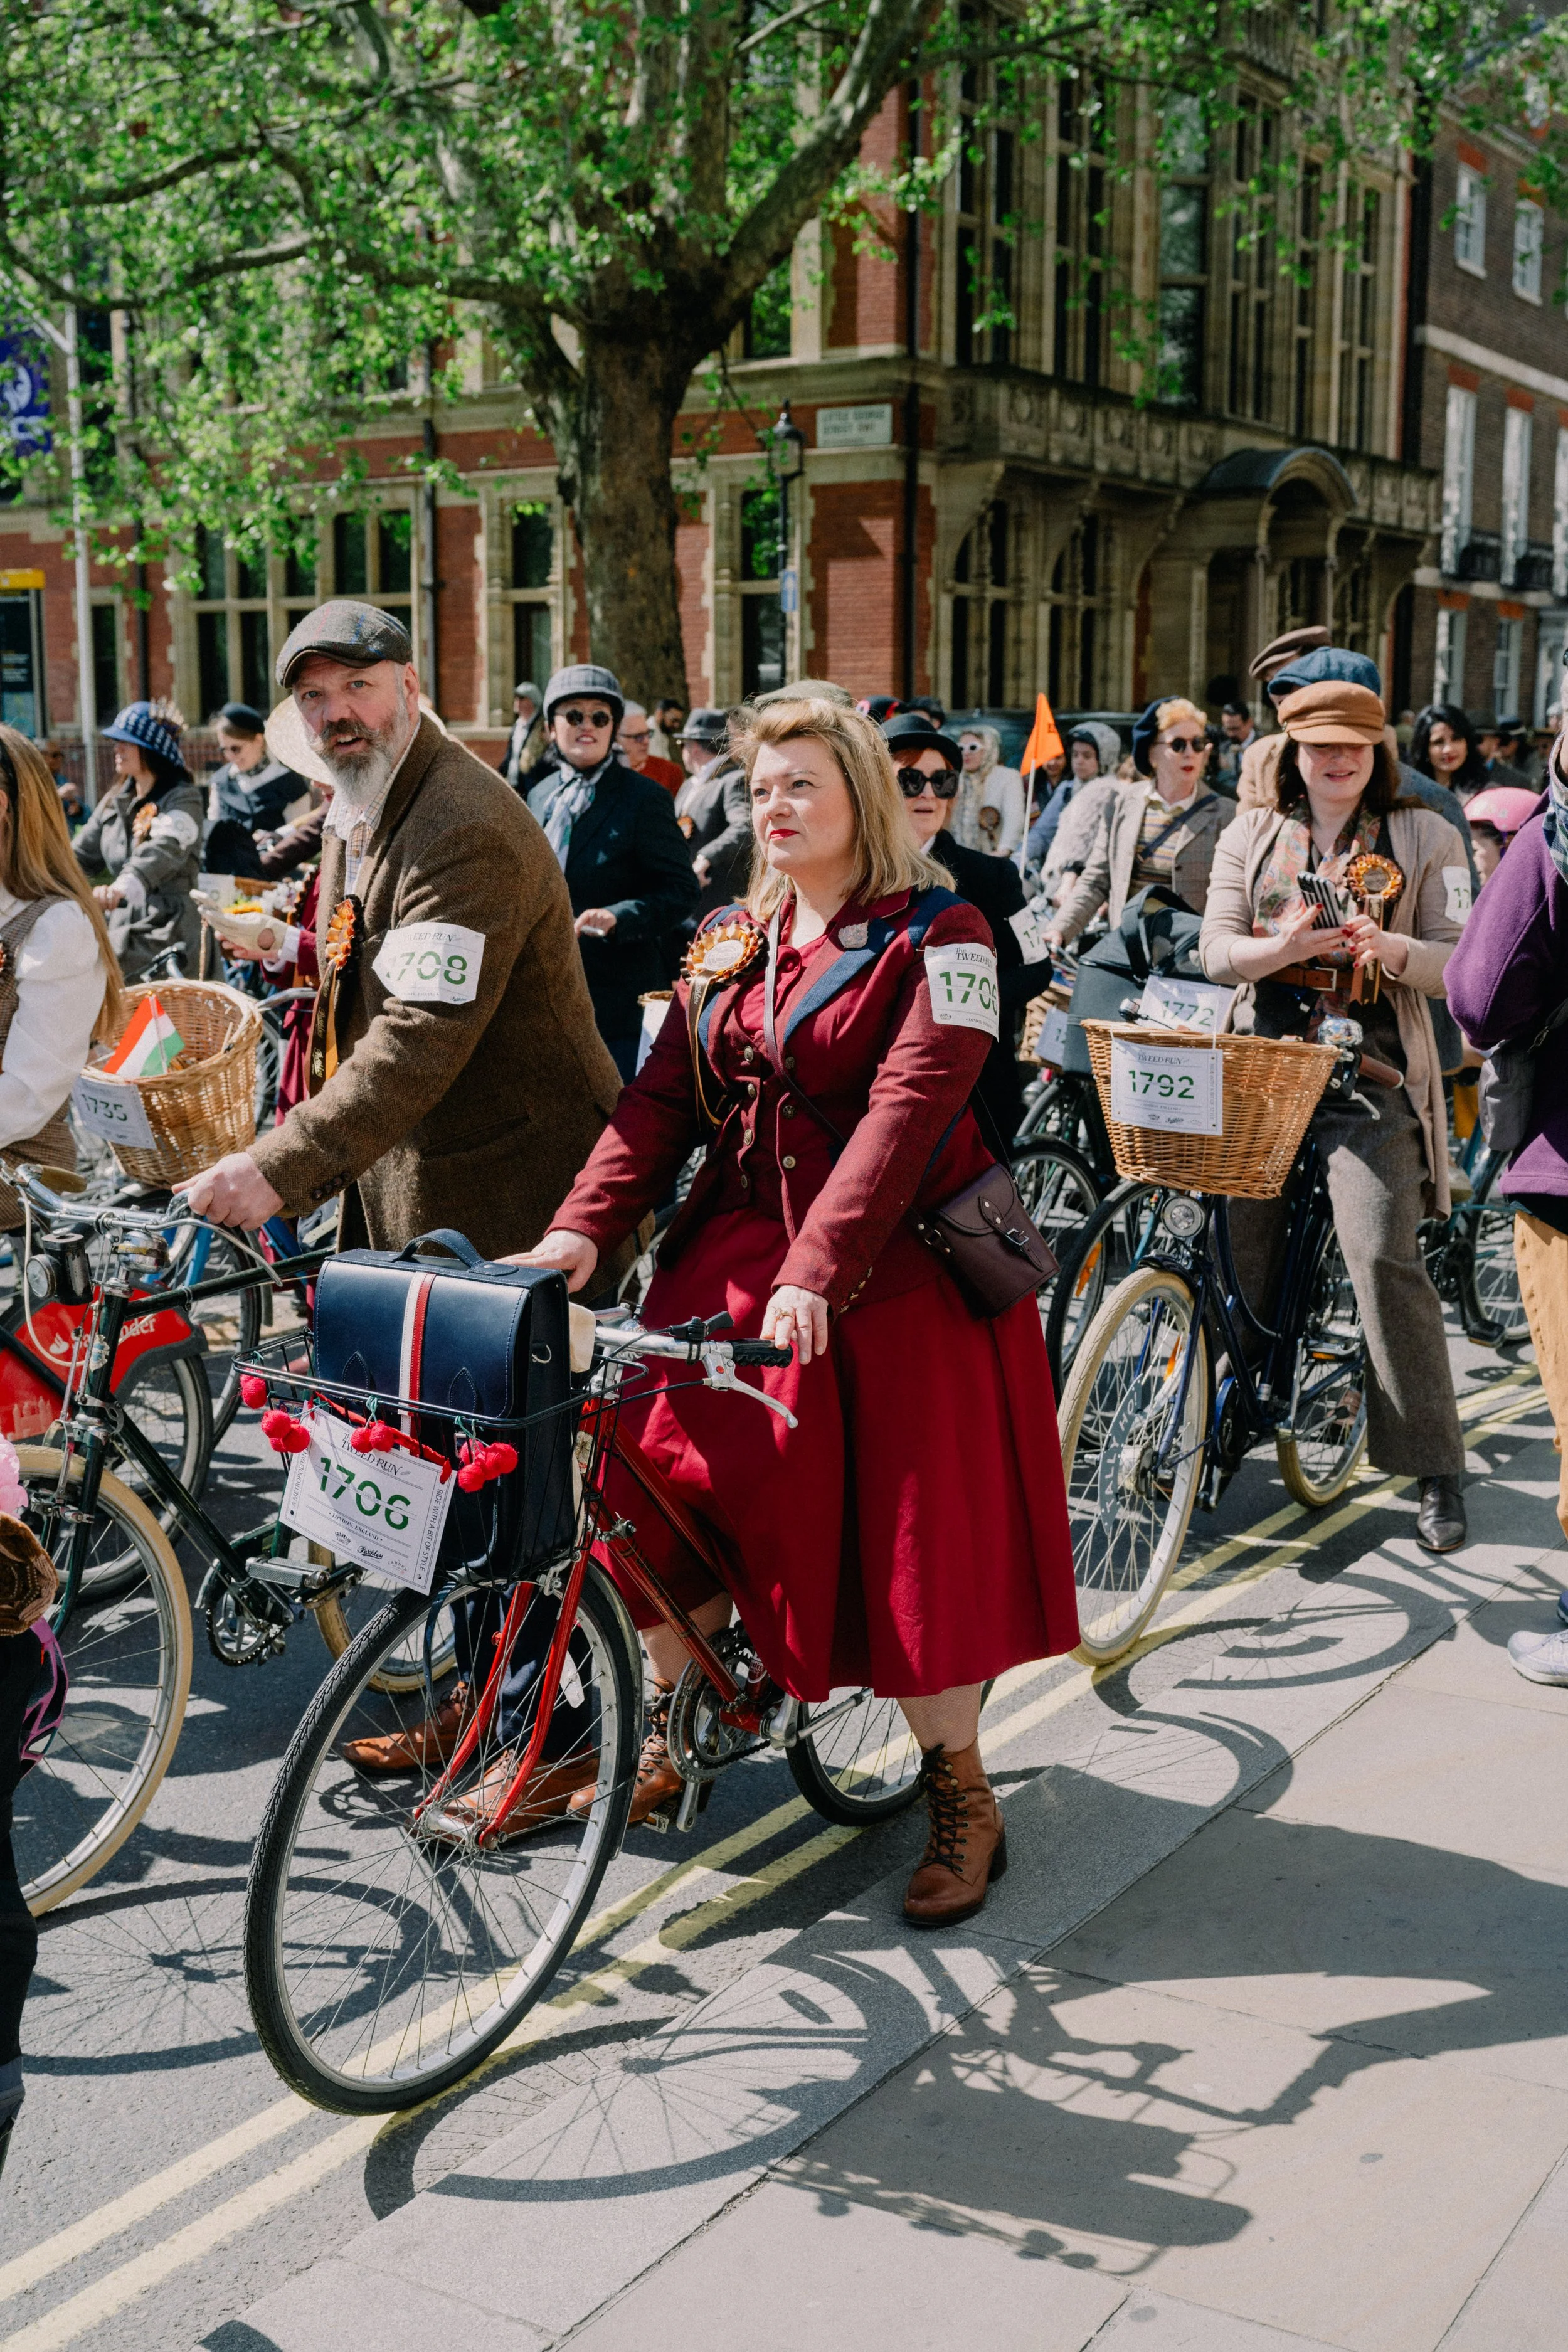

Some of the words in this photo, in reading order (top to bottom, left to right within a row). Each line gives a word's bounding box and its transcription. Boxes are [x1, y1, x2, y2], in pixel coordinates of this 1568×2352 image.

[432, 933, 456, 942] RUN
[386, 951, 467, 985] 708
[956, 953, 985, 964] TWEED
[1163, 1000, 1214, 1026] 1772
[1128, 1070, 1194, 1099] 1792
[82, 1094, 127, 1121] 1735
[1105, 1436, 1119, 1513] TALLY
[1119, 1391, 1137, 1432] HO!
[292, 1451, 308, 1500] METROPOLITAN
[376, 1458, 403, 1476] RUN
[320, 1457, 411, 1530] 1706
[435, 1488, 443, 1505] RIDE
[332, 1513, 353, 1528] LONDON,
[354, 1525, 379, 1540] ENGLAND
[430, 1505, 440, 1523] WITH
[335, 1532, 351, 1543] FRANKLIN
[357, 1545, 383, 1559] Pashley
[425, 1541, 431, 1551] OF
[420, 1552, 429, 1572] STYLE
